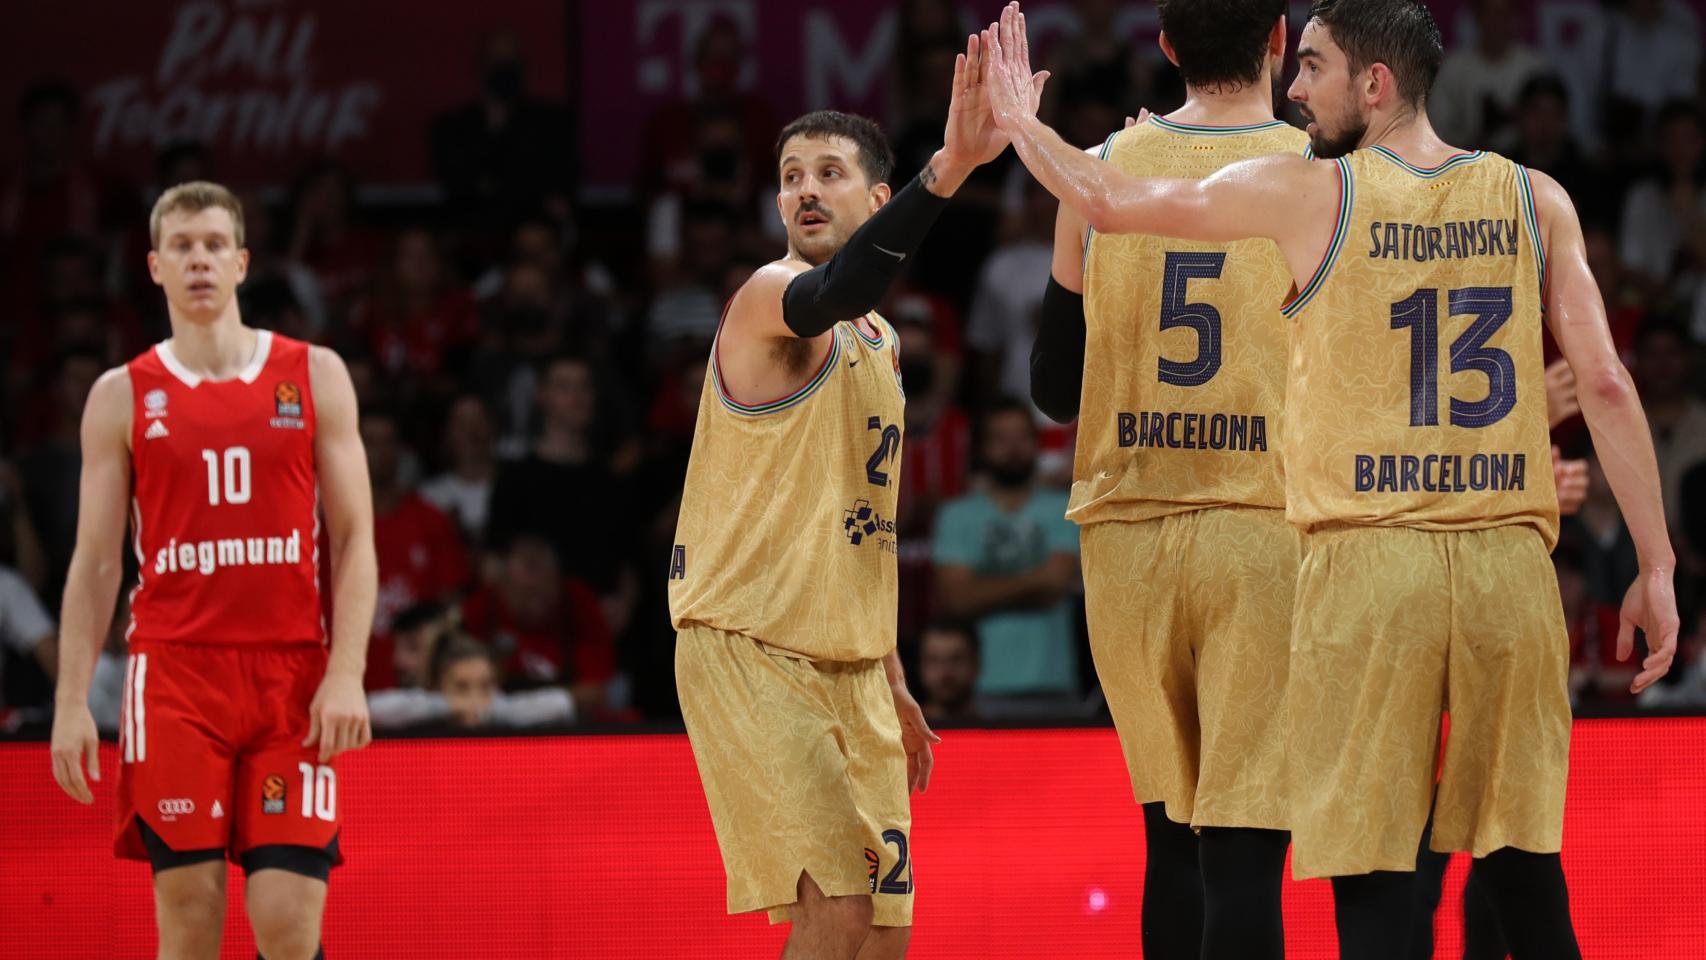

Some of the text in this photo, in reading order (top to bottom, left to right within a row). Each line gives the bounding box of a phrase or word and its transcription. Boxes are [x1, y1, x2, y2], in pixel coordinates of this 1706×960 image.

[1369, 218, 1517, 262] SATORANSKY
[1157, 252, 1226, 387] 5
[1390, 286, 1517, 428] 13
[1118, 413, 1268, 452] BARCELONA
[202, 446, 252, 506] 10
[1355, 453, 1526, 493] BARCELONA
[154, 527, 301, 576] siegmund
[298, 761, 337, 823] 10
